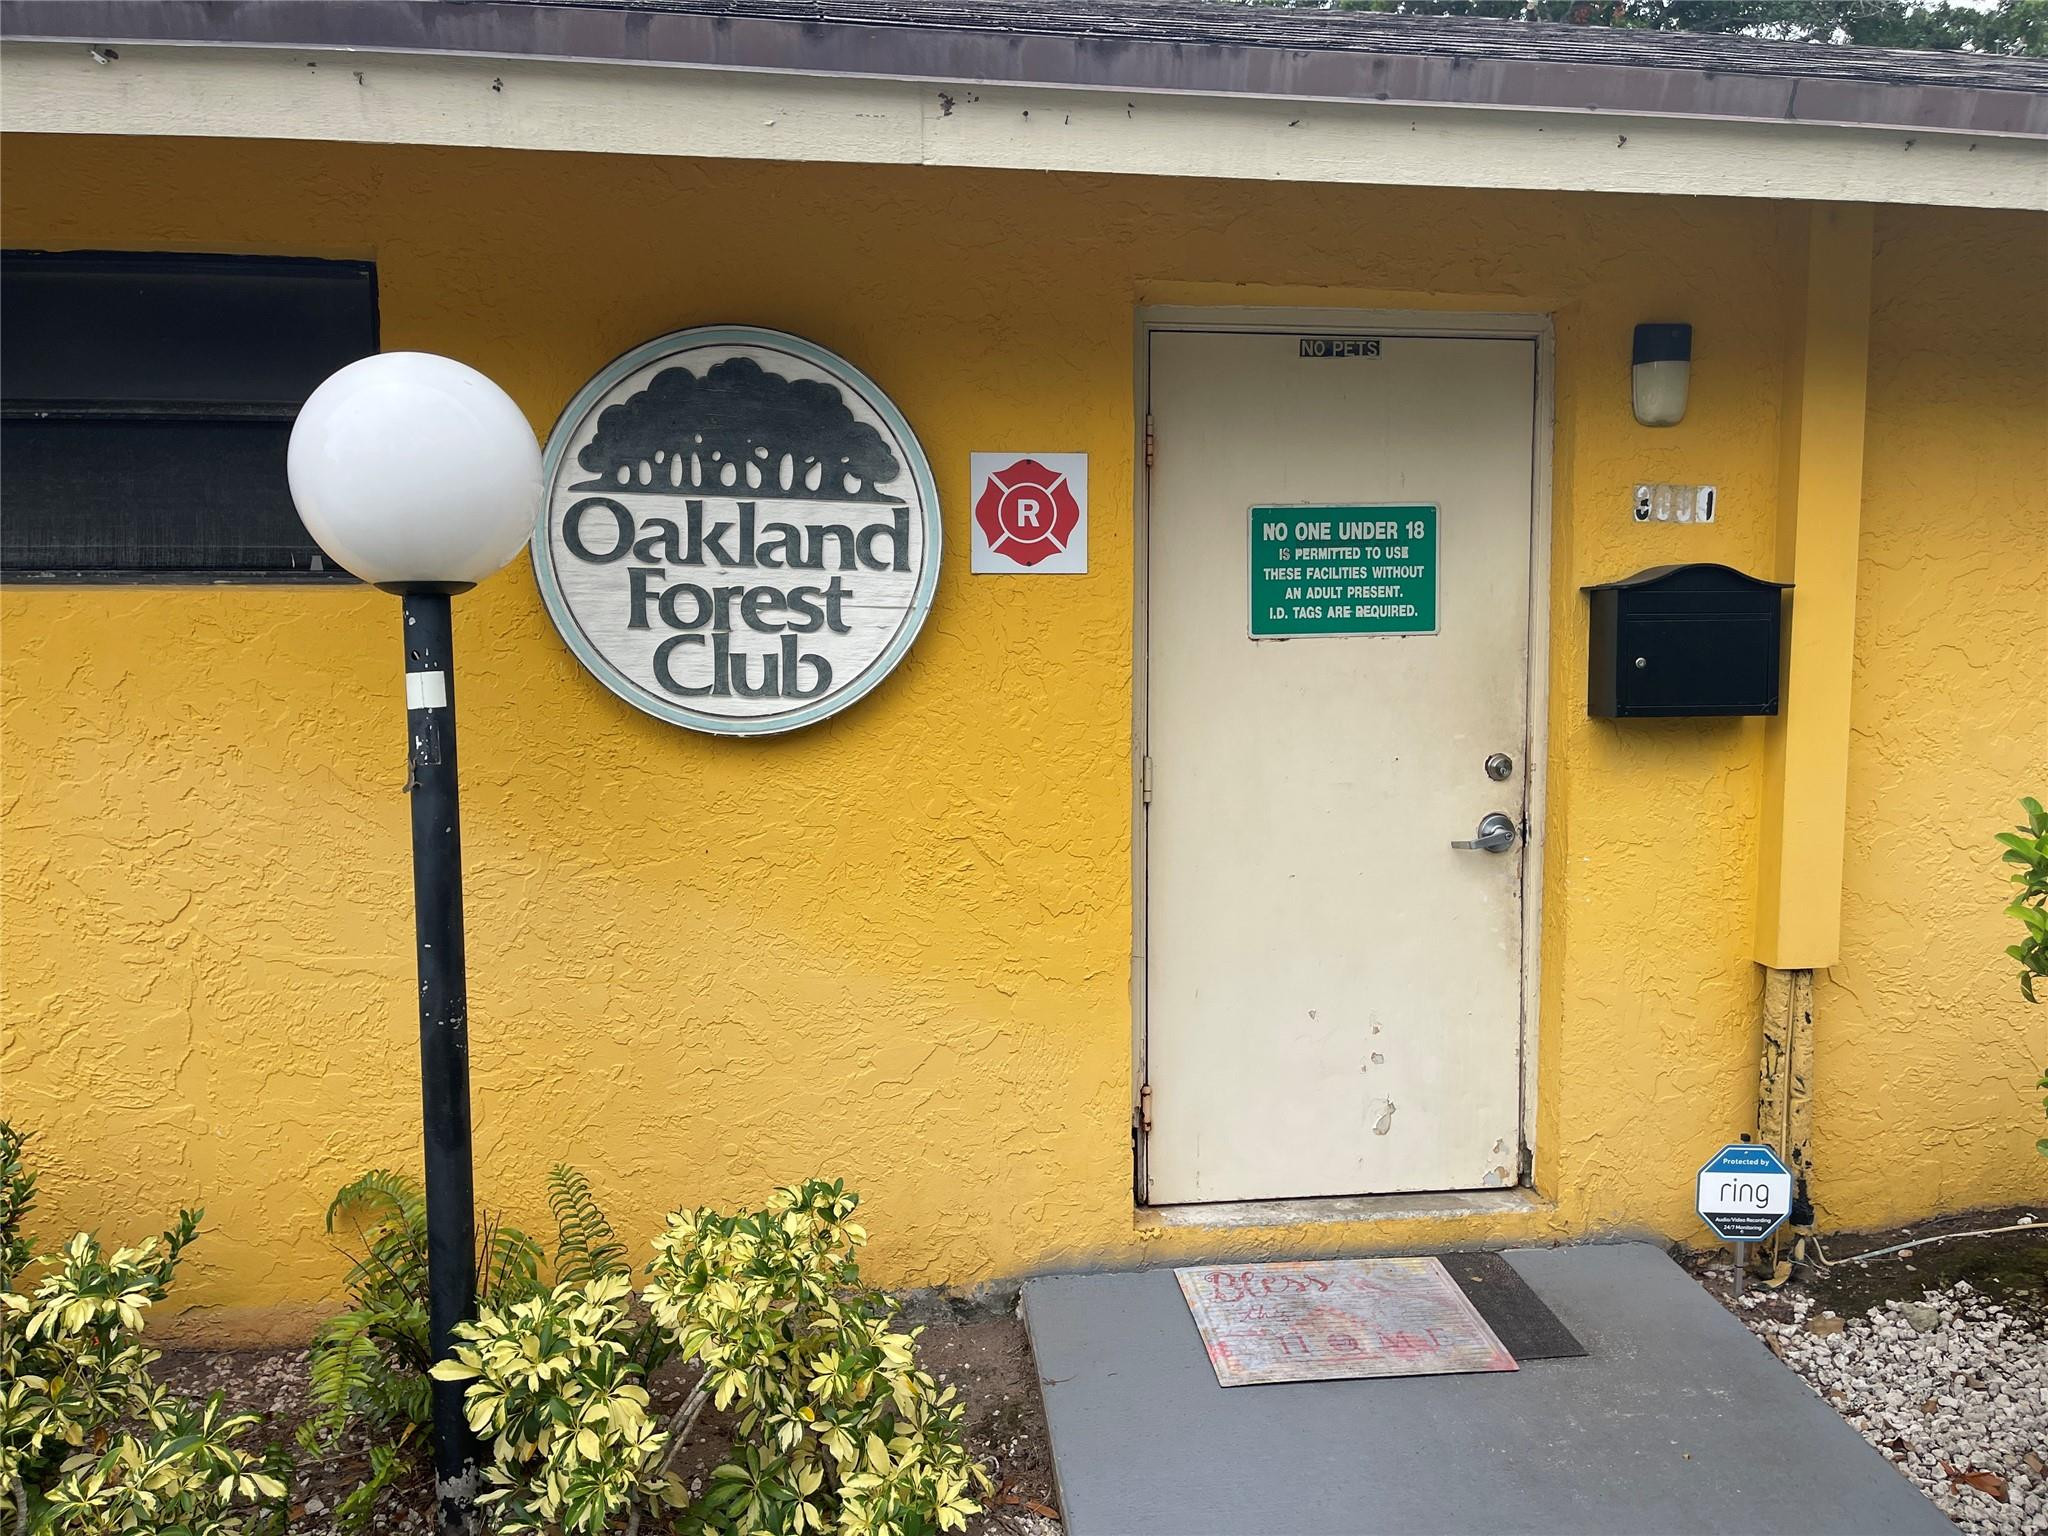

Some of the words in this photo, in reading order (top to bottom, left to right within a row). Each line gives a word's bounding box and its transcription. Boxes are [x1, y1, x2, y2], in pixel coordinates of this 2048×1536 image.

[1301, 340, 1326, 356] NO
[1332, 340, 1378, 357] PETS
[1017, 498, 1040, 527] R
[562, 497, 912, 573] Oakland
[1263, 522, 1288, 541] NO
[1295, 521, 1332, 541] ONE
[1338, 521, 1399, 540] UNDER
[1405, 520, 1425, 540] 18
[1279, 547, 1290, 561] IS
[1295, 546, 1361, 561] PERMITTED
[1365, 546, 1381, 560] TO
[1385, 546, 1409, 559] USE
[1263, 567, 1302, 581] THESE
[1306, 566, 1368, 580] FACILITIES
[1372, 565, 1425, 579] WITHOUT
[627, 567, 853, 634] Forest
[1285, 586, 1301, 600] AN
[1306, 586, 1343, 599] ADULT
[1347, 585, 1403, 599] PRESENT.
[1269, 606, 1288, 620] I.D.
[1293, 606, 1323, 619] TAGS
[1327, 605, 1351, 618] ARE
[1355, 604, 1418, 619] REQUIRED.
[653, 631, 833, 699] Club
[1722, 1157, 1759, 1166] Protected
[1760, 1158, 1770, 1167] by
[1720, 1177, 1769, 1209] ring
[1204, 1271, 1334, 1302] Bless
